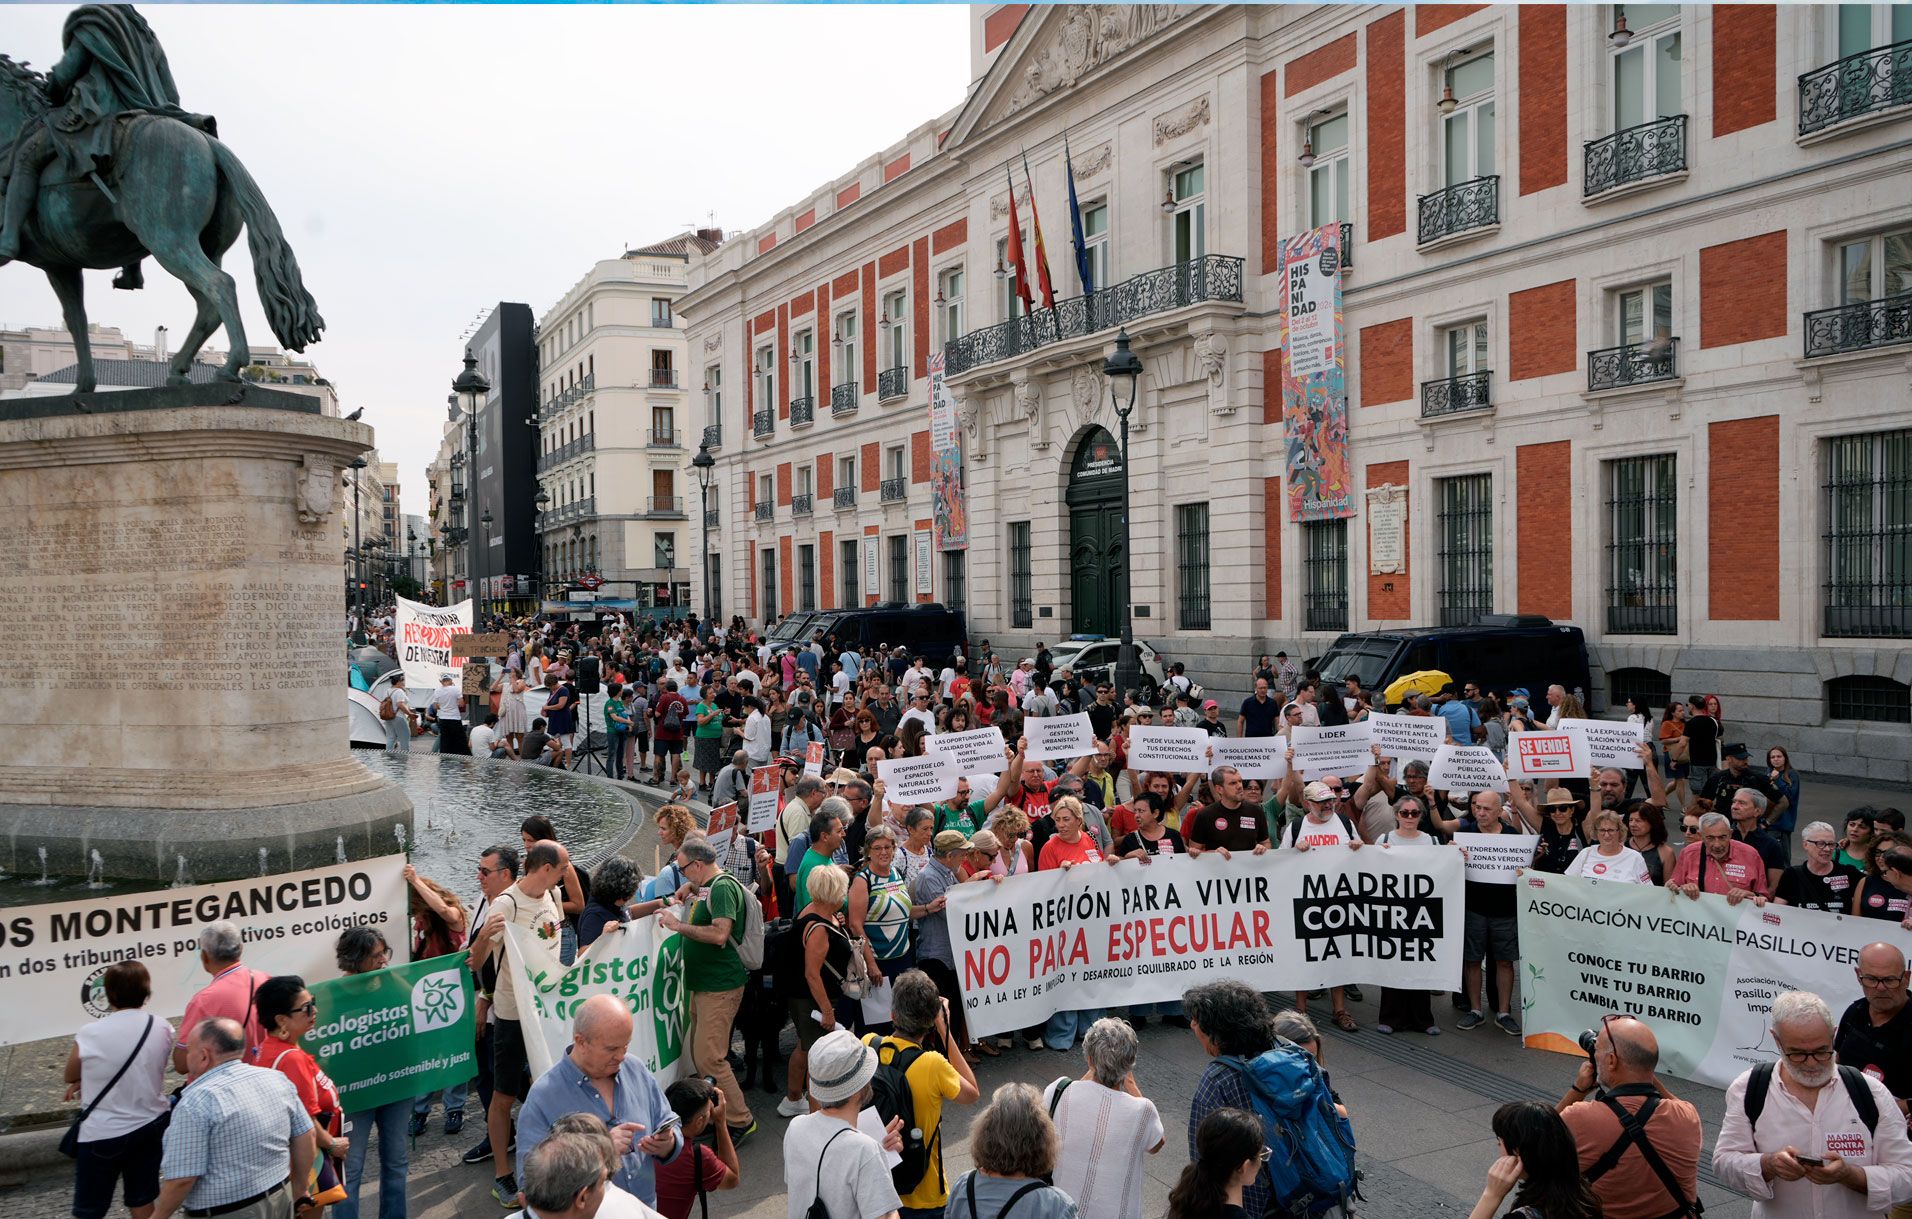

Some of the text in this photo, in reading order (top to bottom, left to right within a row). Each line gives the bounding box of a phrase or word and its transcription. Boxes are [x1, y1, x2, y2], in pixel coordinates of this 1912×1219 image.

[1291, 263, 1309, 279] HIS
[1291, 278, 1306, 292] PA
[1291, 290, 1304, 304] NI
[1292, 301, 1316, 317] DAD
[934, 400, 946, 410] DAD
[1087, 459, 1114, 468] PRESIDENCIA
[1077, 469, 1101, 478] COMUNIDAD
[1304, 499, 1348, 510] Hispanidad
[290, 530, 325, 541] MADRID
[279, 552, 294, 560] REY
[224, 592, 289, 601] MODERNIZO
[266, 602, 297, 610] DICTO
[237, 652, 271, 660] APOYO
[406, 646, 419, 662] DE
[420, 647, 450, 668] NUESTRA
[252, 681, 271, 690] LAS
[1319, 731, 1346, 739] LIDER
[1373, 728, 1411, 736] DEFENDERTE
[1600, 728, 1637, 737] EXPULSIÓN
[946, 733, 991, 744] OPORTUNIDADES
[1042, 736, 1079, 744] URBANÍSTICA
[1520, 739, 1570, 754] SE VENDE
[962, 754, 996, 763] DORMITORIO
[894, 763, 933, 773] DESPROTEGE
[904, 771, 933, 780] ESPACIOS
[899, 779, 934, 788] NATURALES
[899, 786, 942, 797] PRESERVADOS
[1302, 872, 1435, 898] MADRID
[51, 872, 372, 942] MONTEGANCEDO
[964, 876, 1270, 942] UNA REGIÓN PARA VIVIR
[1302, 903, 1435, 930] CONTRA
[1528, 899, 1859, 964] ASOCIACIÓN VECINAL PASILLO VER
[19, 910, 388, 975] dos tribunales ecológicos
[1305, 934, 1436, 962] LA LIDER
[964, 910, 1273, 991] NO PARA ESPECULAR
[1568, 952, 1705, 985] CONOCE TU BARRIO
[966, 951, 1274, 1010] NO A LA LEY DE IMPULSO Y DESARROLLO EQUILIBRADO DE LA REGIÓN
[1736, 977, 1776, 986] Asociación
[1580, 972, 1691, 1003] VIVE TU BARRIO
[1734, 989, 1771, 999] Pasillo
[1570, 990, 1702, 1026] CAMBIA TU BARRIO
[304, 1004, 408, 1041] ecologistas
[319, 1022, 410, 1058] en acción
[350, 1073, 387, 1090] mundo
[389, 1058, 441, 1080] sostenible
[443, 1057, 448, 1069] y
